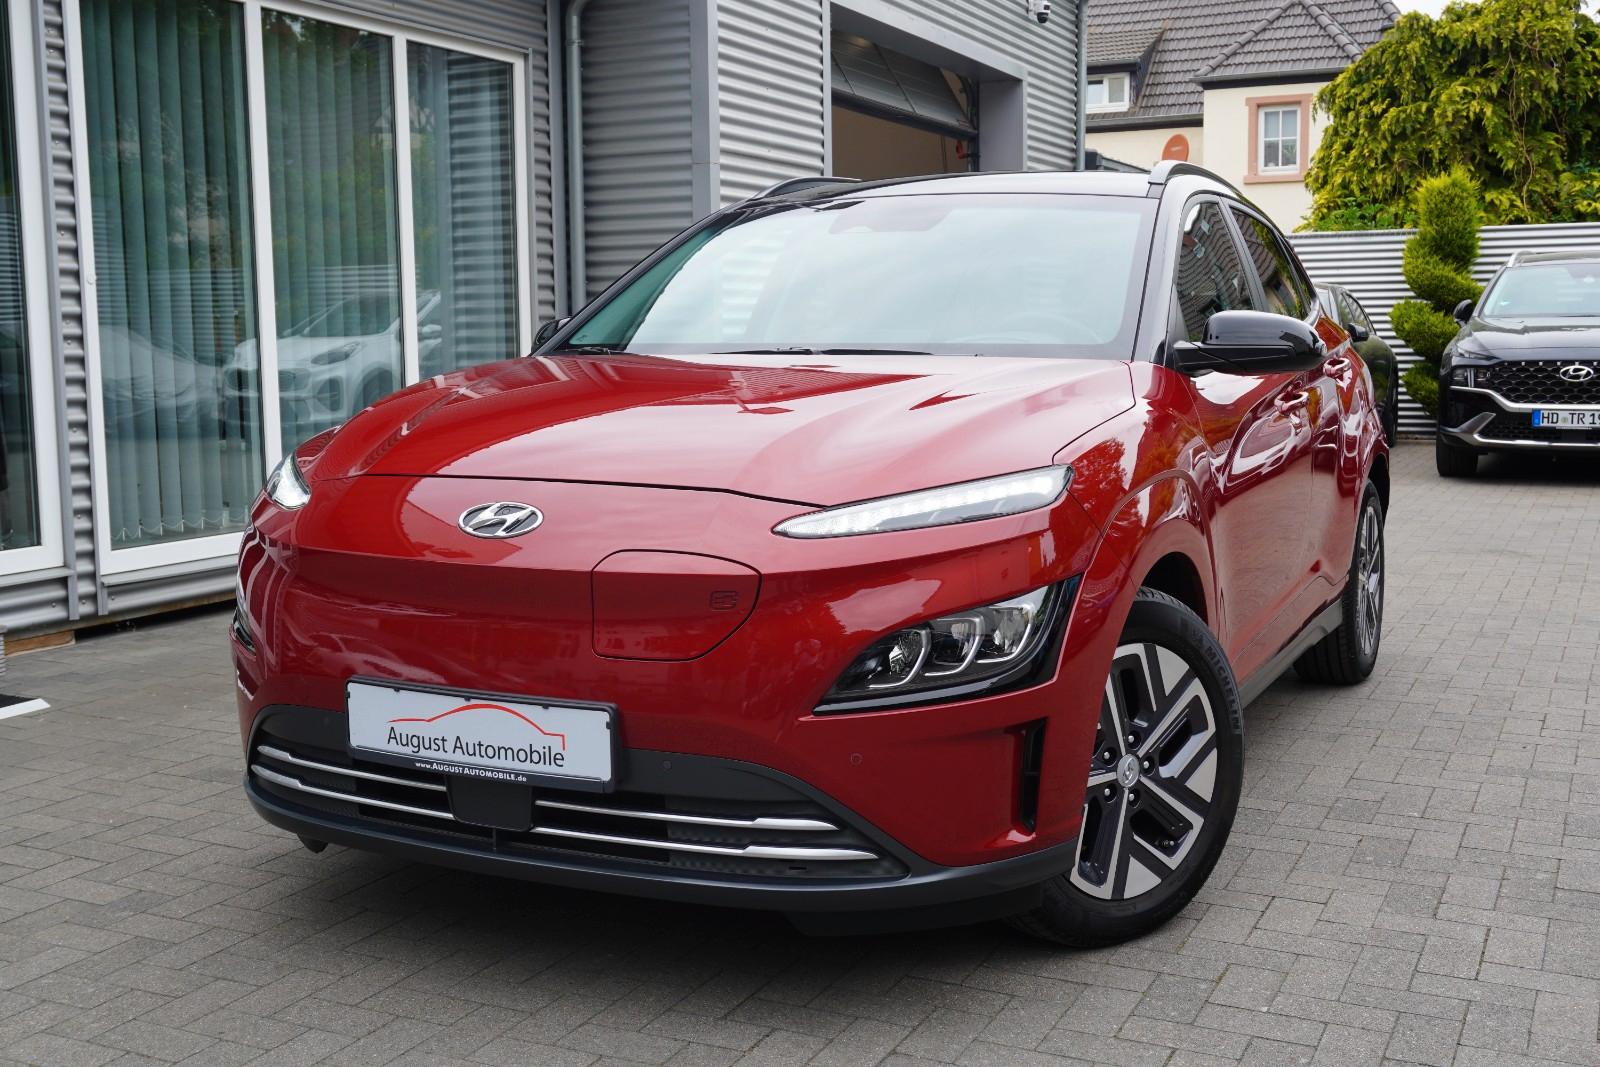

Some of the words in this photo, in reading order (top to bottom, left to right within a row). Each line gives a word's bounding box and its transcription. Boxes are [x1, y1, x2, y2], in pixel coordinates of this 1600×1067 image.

[1541, 412, 1559, 424] HD
[1568, 412, 1586, 425] TR
[1205, 646, 1241, 731] MICHELIN
[387, 726, 447, 754] August
[453, 735, 565, 768] Automobile
